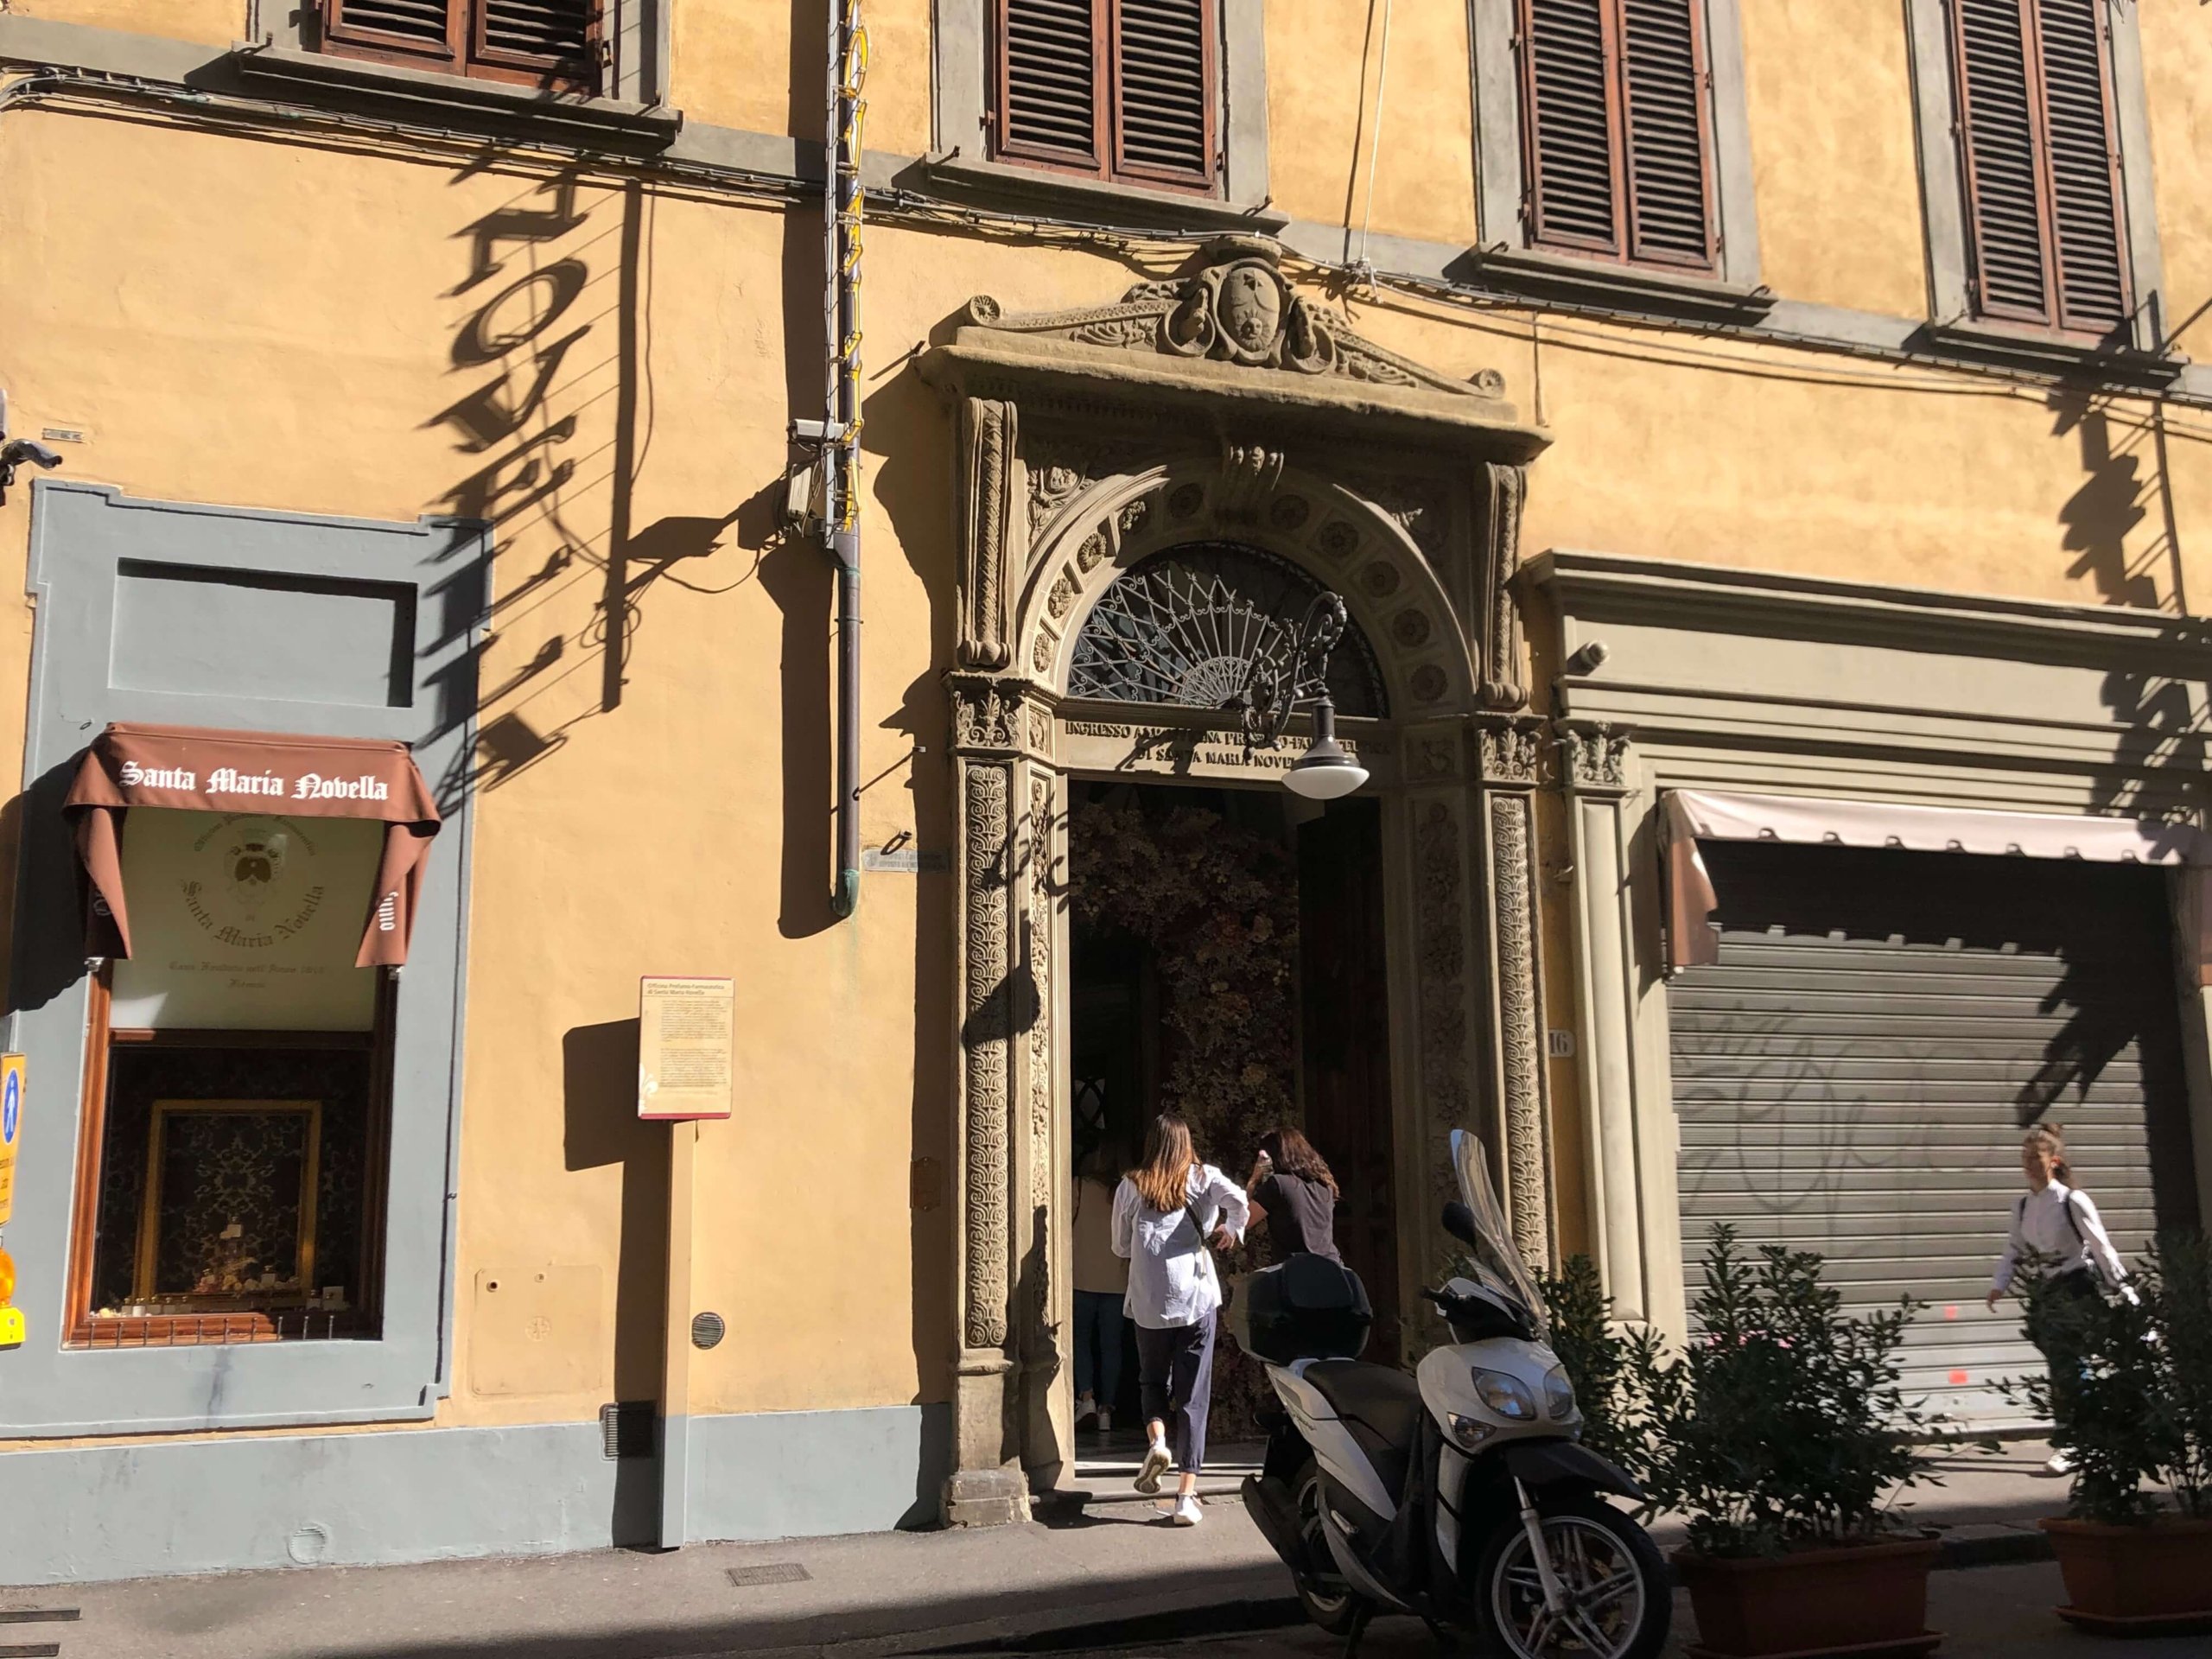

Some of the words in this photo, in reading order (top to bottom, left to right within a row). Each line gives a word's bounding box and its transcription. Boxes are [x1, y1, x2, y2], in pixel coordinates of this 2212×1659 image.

[1065, 721, 1130, 739] INGRESSO
[119, 760, 196, 791] Santa
[205, 768, 284, 796] Maria
[290, 772, 389, 800] Novella
[179, 880, 213, 930] Santa
[214, 926, 273, 947] Maria
[275, 886, 324, 939] Novella
[1549, 1033, 1568, 1054] 16
